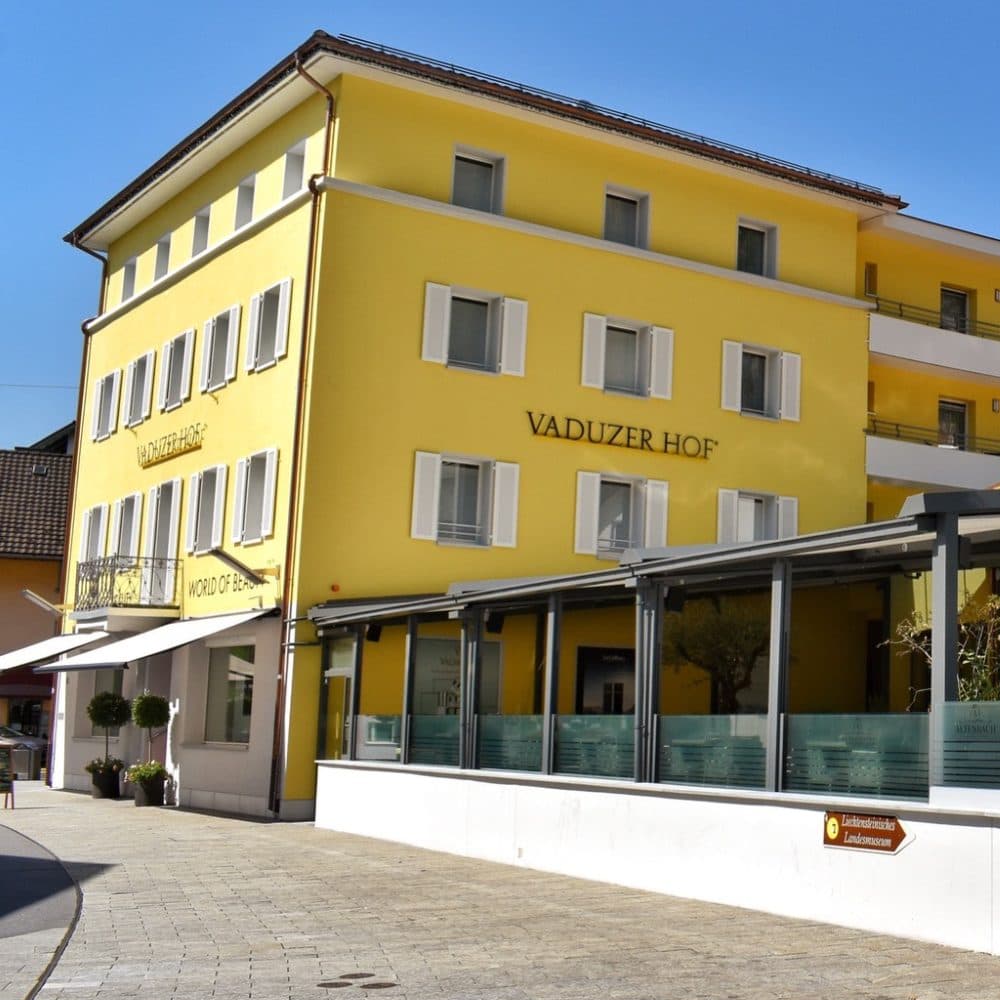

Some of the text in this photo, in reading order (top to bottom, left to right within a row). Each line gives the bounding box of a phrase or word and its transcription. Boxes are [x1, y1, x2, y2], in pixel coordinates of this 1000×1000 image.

[137, 422, 204, 467] VADUZER HOF
[526, 411, 714, 460] VADUZER HOF
[189, 573, 264, 598] WORLD OF BEAU
[843, 831, 892, 847] Landesmuseum
